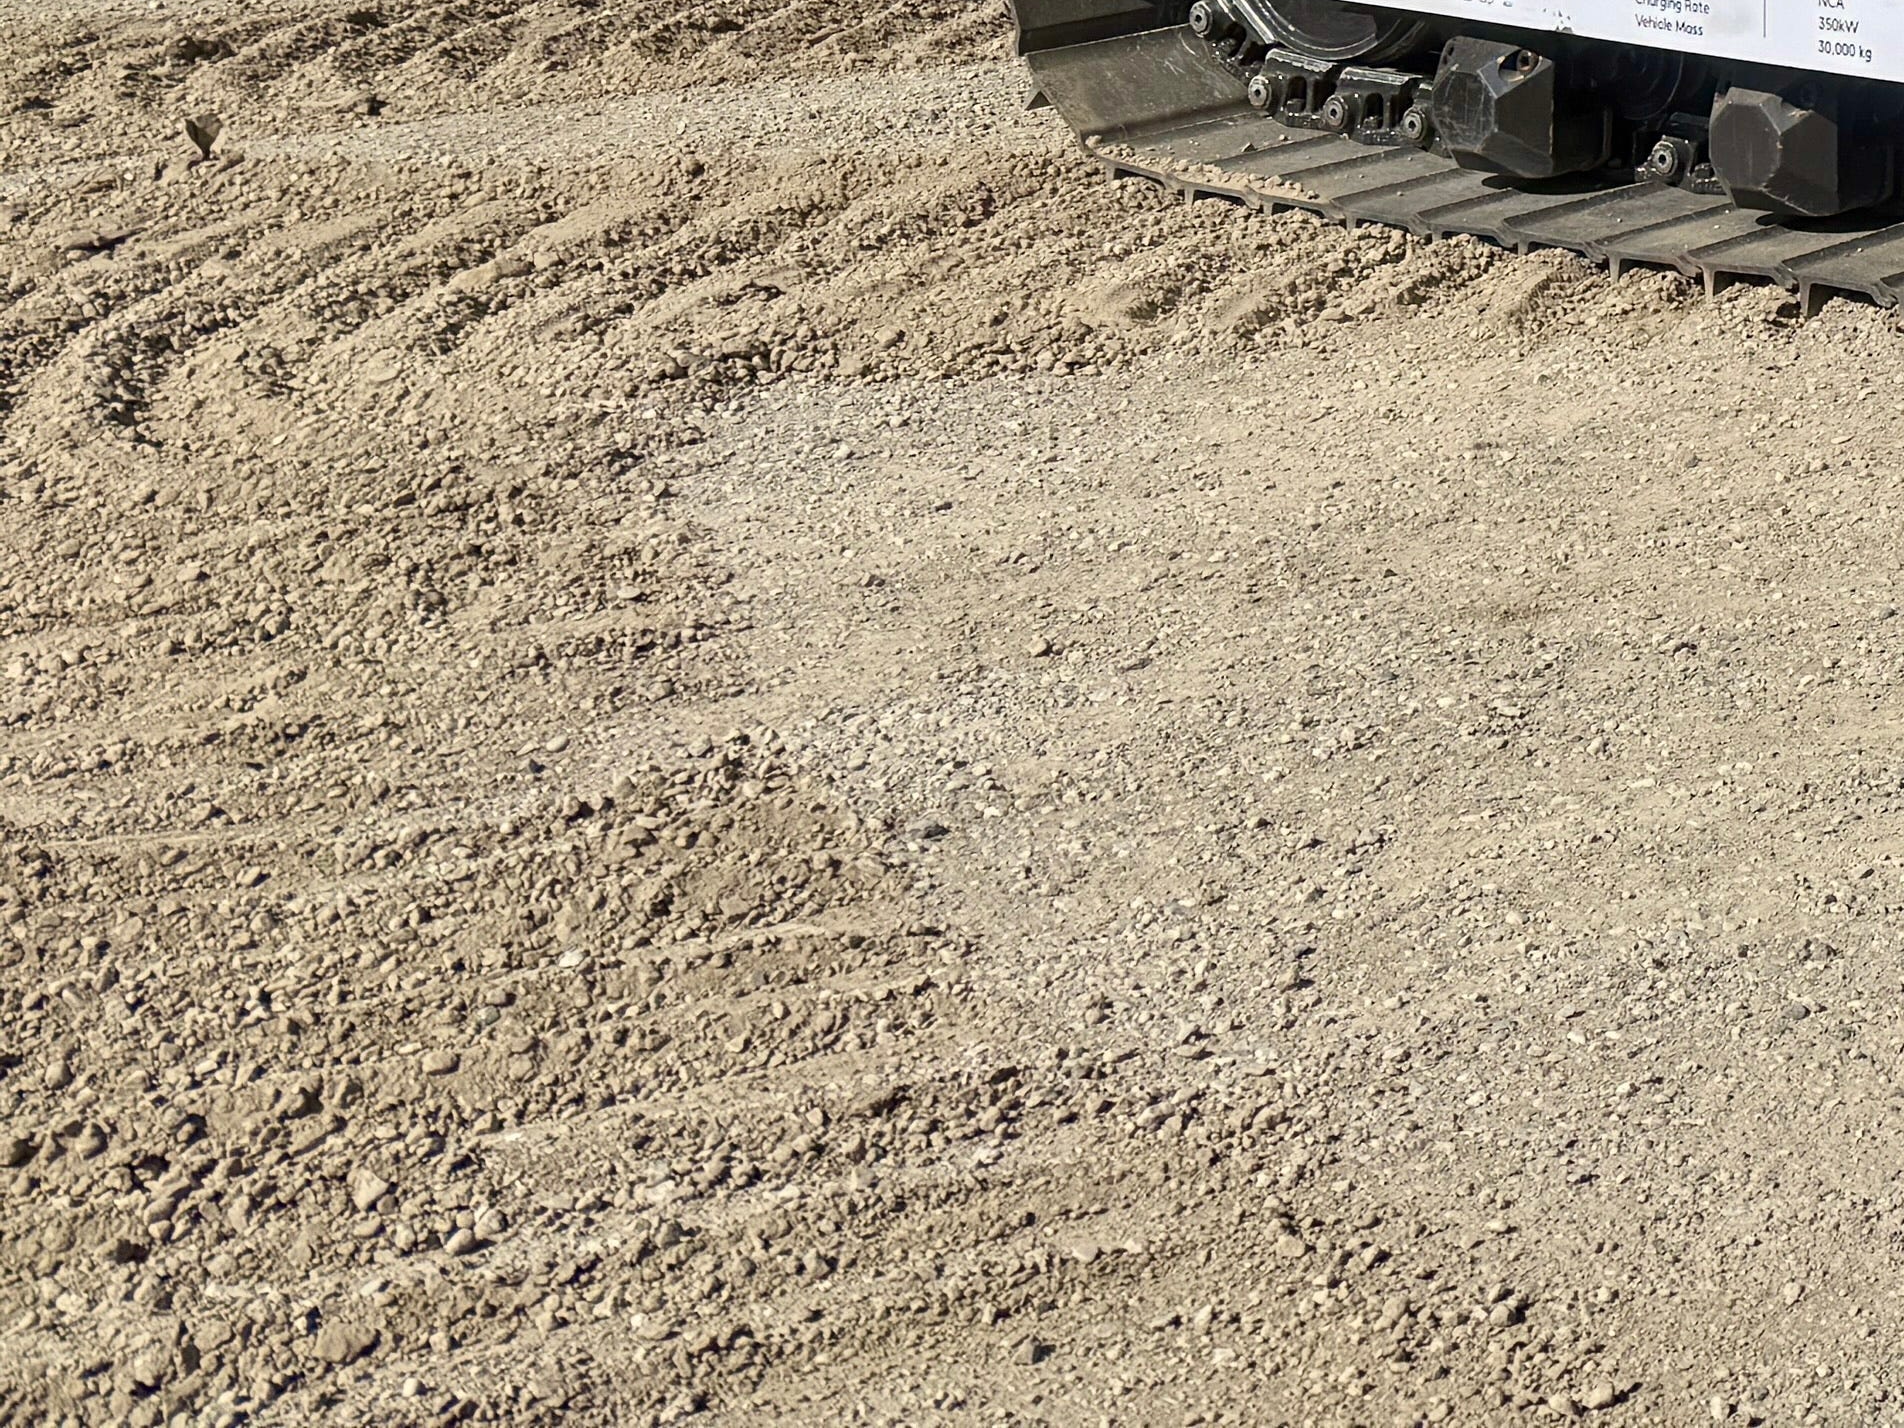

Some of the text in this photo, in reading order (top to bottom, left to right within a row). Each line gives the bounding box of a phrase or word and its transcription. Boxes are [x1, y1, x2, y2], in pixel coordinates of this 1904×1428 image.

[1635, 13, 1704, 36] Vehicle Mass
[1818, 16, 1860, 34] 350kW
[1858, 45, 1872, 63] kg
